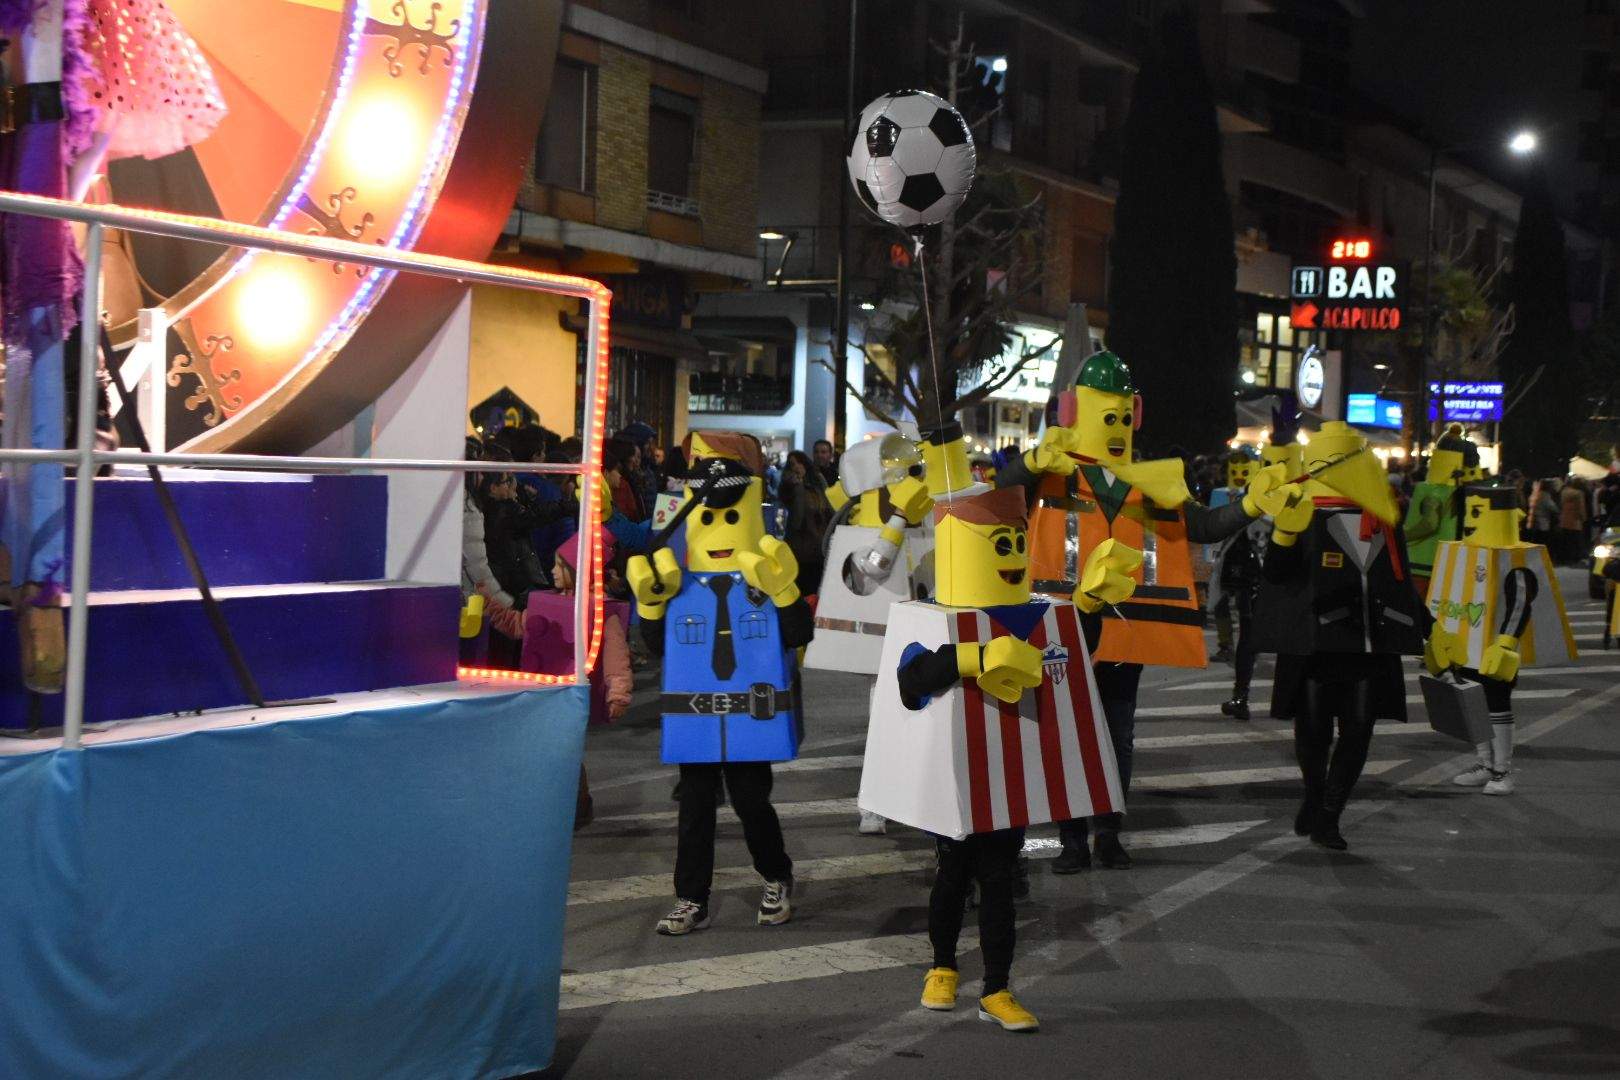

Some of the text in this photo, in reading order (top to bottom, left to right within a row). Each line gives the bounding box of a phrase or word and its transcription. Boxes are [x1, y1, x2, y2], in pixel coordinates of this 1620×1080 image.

[1327, 266, 1396, 299] BAR
[1321, 306, 1400, 330] ACAPULCO
[656, 510, 666, 524] 2
